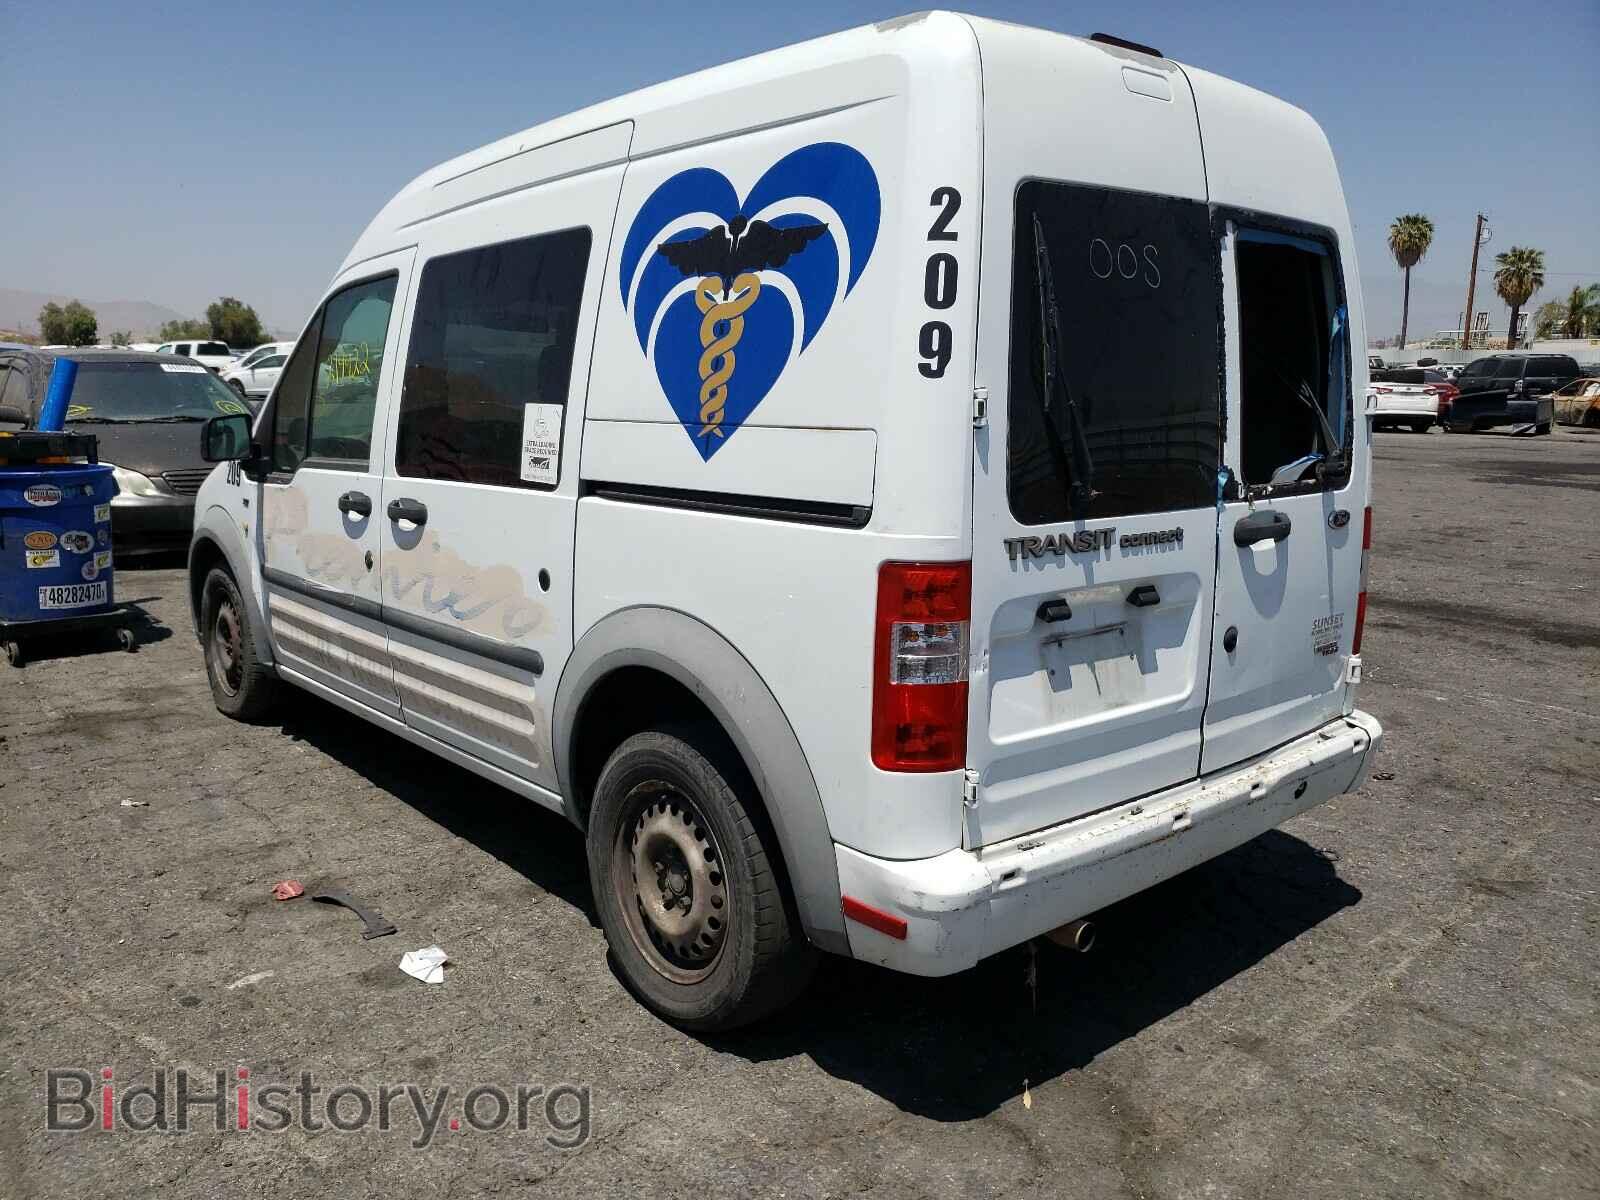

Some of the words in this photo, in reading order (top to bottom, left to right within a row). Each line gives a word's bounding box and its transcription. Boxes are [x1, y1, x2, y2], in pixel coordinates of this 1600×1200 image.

[918, 186, 962, 379] 209
[226, 460, 240, 487] 209
[1003, 527, 1116, 560] TRANSIT
[1119, 527, 1184, 548] connect
